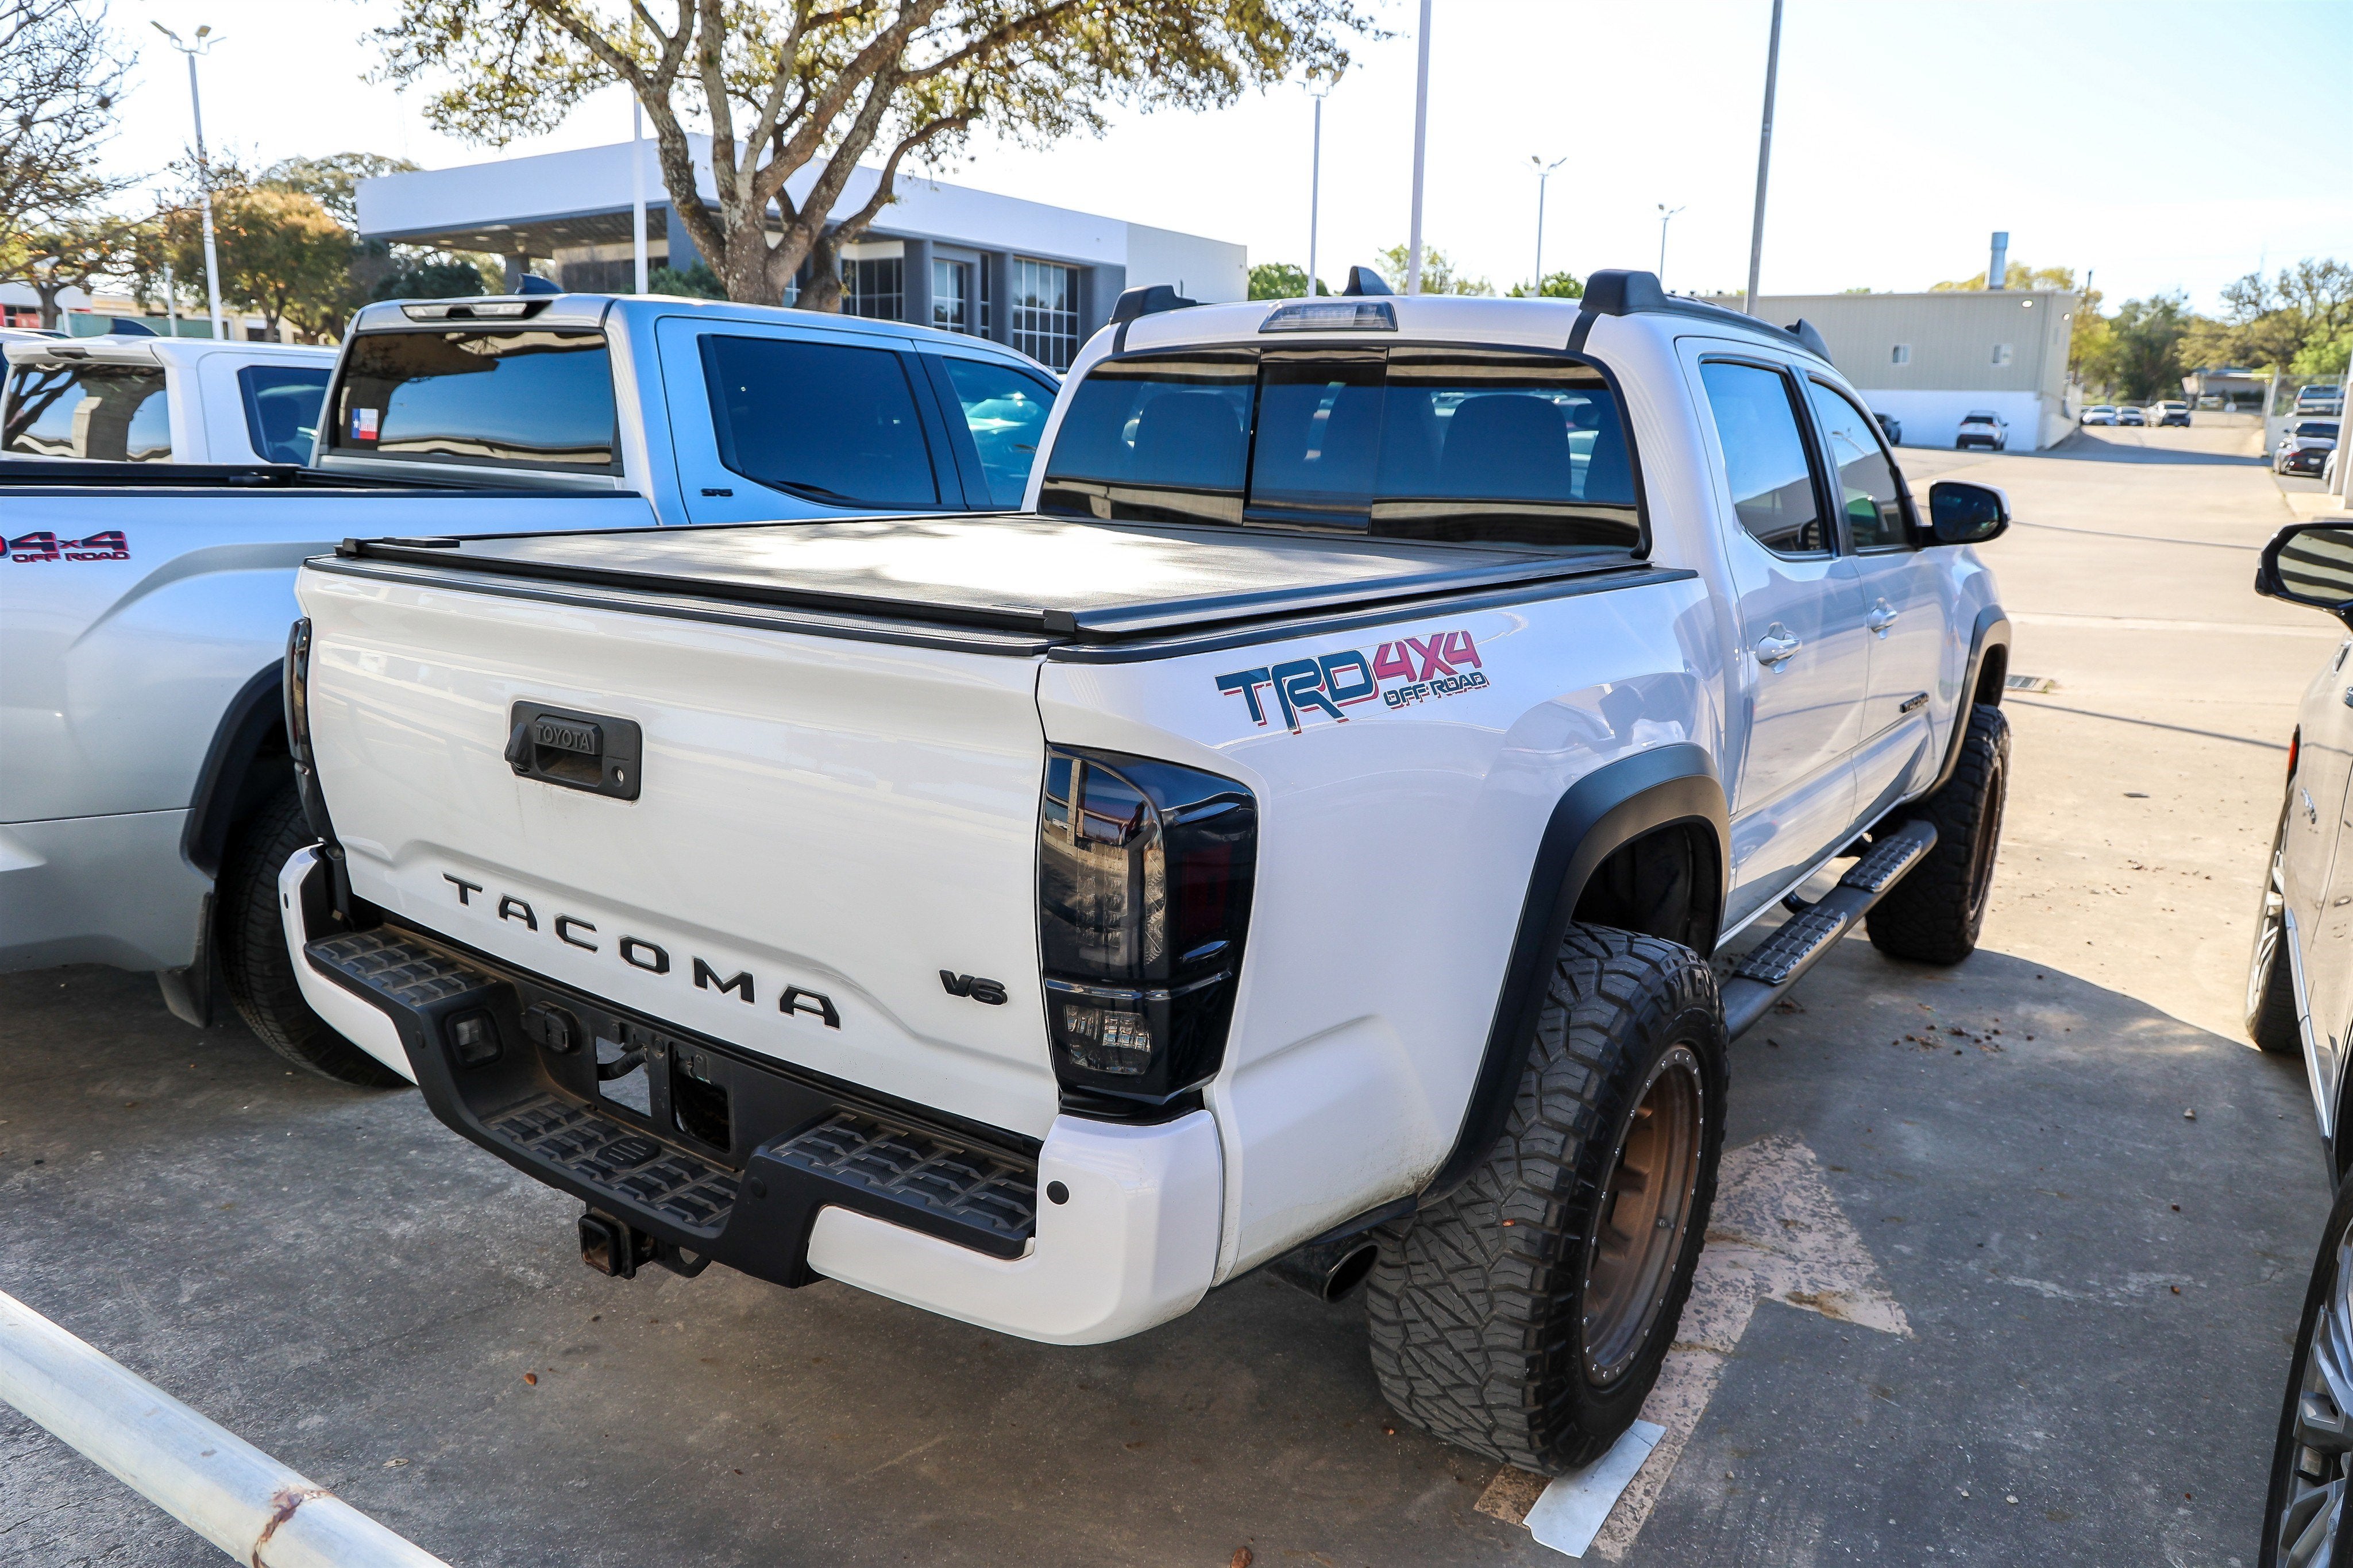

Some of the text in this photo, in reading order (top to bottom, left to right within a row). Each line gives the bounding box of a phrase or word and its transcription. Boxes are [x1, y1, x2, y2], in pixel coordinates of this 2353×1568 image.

[12, 551, 130, 563] OFF ROAD
[1383, 671, 1490, 710] OFF ROAD
[535, 724, 591, 751] TOYOTA
[442, 872, 843, 1032] TACOMA
[939, 969, 1008, 1006] V6
